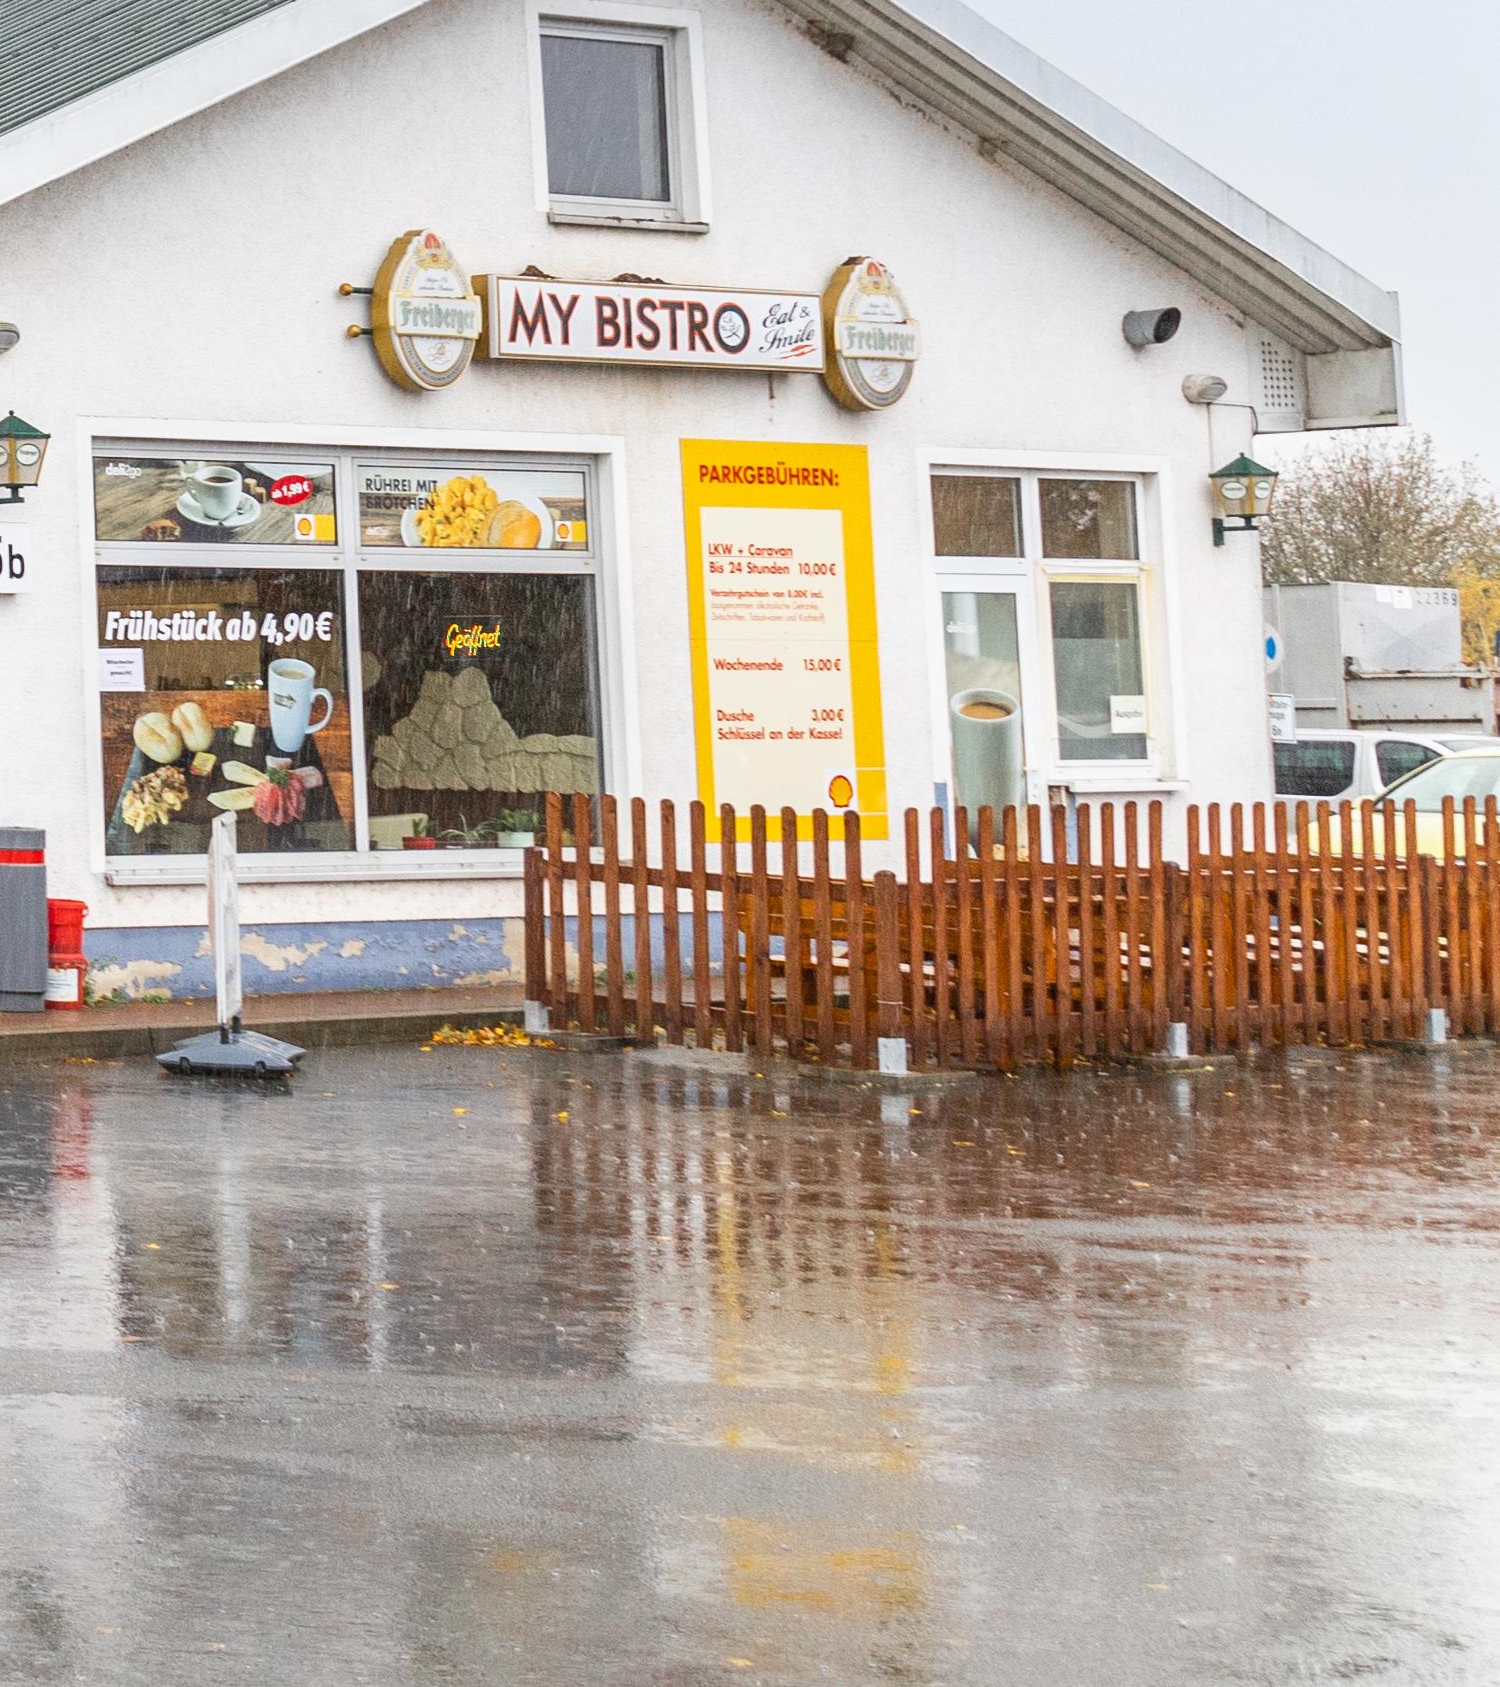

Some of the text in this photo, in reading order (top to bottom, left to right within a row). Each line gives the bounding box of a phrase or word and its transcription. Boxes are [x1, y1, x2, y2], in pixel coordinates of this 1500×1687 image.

[400, 300, 476, 334] Freiberger
[507, 285, 751, 355] MY BISTRO
[762, 301, 798, 328] Eat
[758, 319, 816, 353] Smile
[845, 325, 916, 357] Freiberger
[365, 473, 439, 493] RÜHREI MIT
[699, 462, 840, 487] PARKGEBÜHREN:
[708, 543, 733, 556] LKW
[748, 543, 793, 557] Caravan
[709, 562, 724, 574] Bis
[729, 562, 742, 574] 24
[747, 562, 790, 574] Stunden
[104, 610, 224, 642] Frühstück
[225, 610, 257, 642] ab
[444, 622, 501, 657] Geöffnet
[713, 658, 783, 671] Wochenende
[716, 708, 755, 722] Dusche
[717, 726, 843, 741] Schlüssel an der Kasse!
